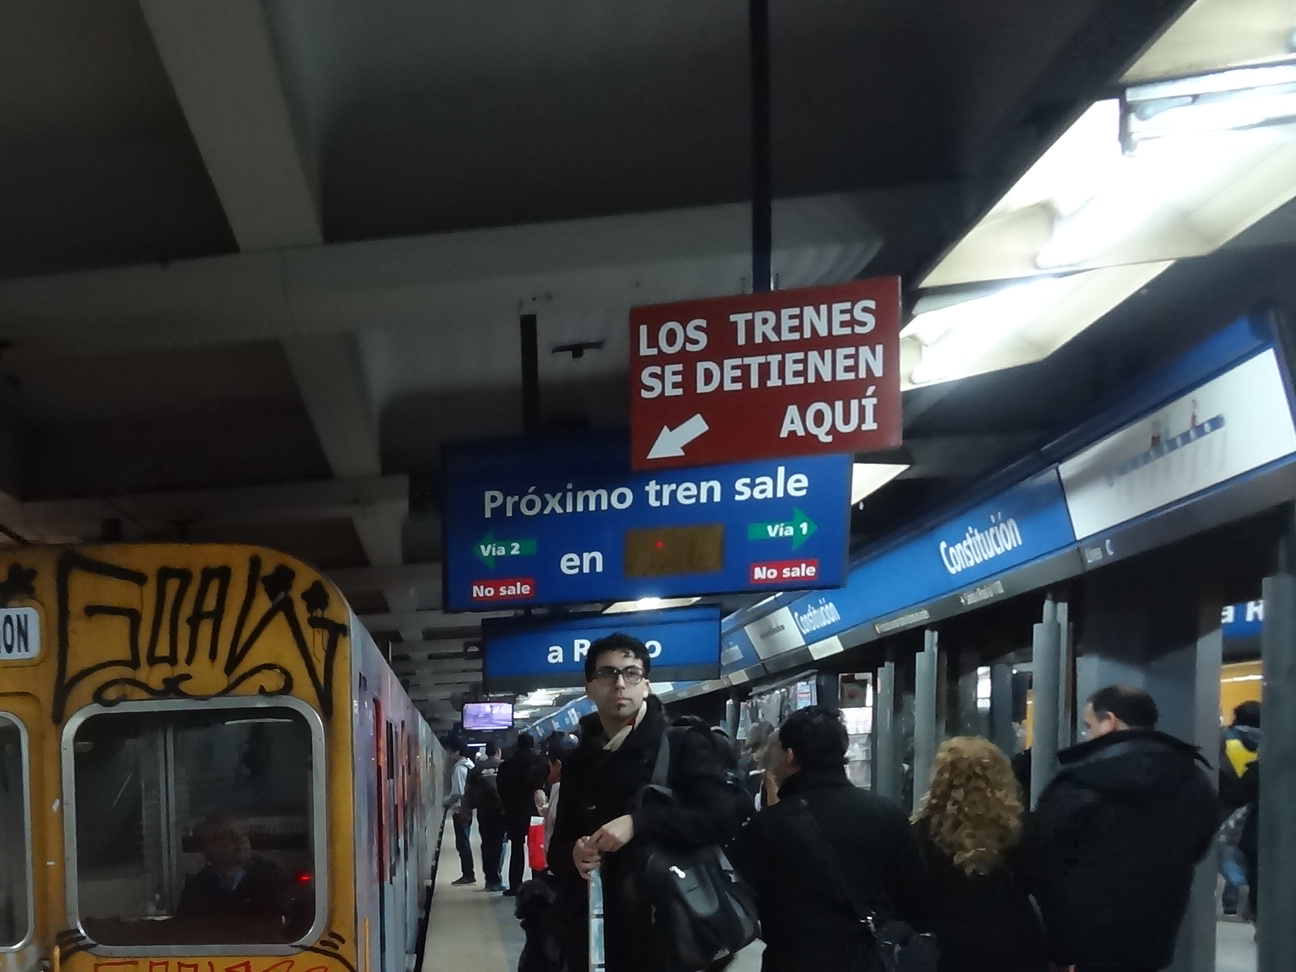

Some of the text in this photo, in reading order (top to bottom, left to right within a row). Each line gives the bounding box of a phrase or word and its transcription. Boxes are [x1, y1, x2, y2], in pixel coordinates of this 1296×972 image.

[638, 299, 877, 357] LOS TRENES
[640, 343, 884, 399] SE DETIENEN
[779, 385, 878, 444] AQUÍ
[483, 466, 809, 519] Próximo tren sale
[766, 521, 809, 539] Vía 1
[939, 511, 1024, 576] Constitución
[479, 541, 521, 558] Vía 2
[559, 548, 604, 576] en
[752, 562, 817, 582] No sale
[472, 581, 531, 598] No sale
[547, 644, 564, 664] a
